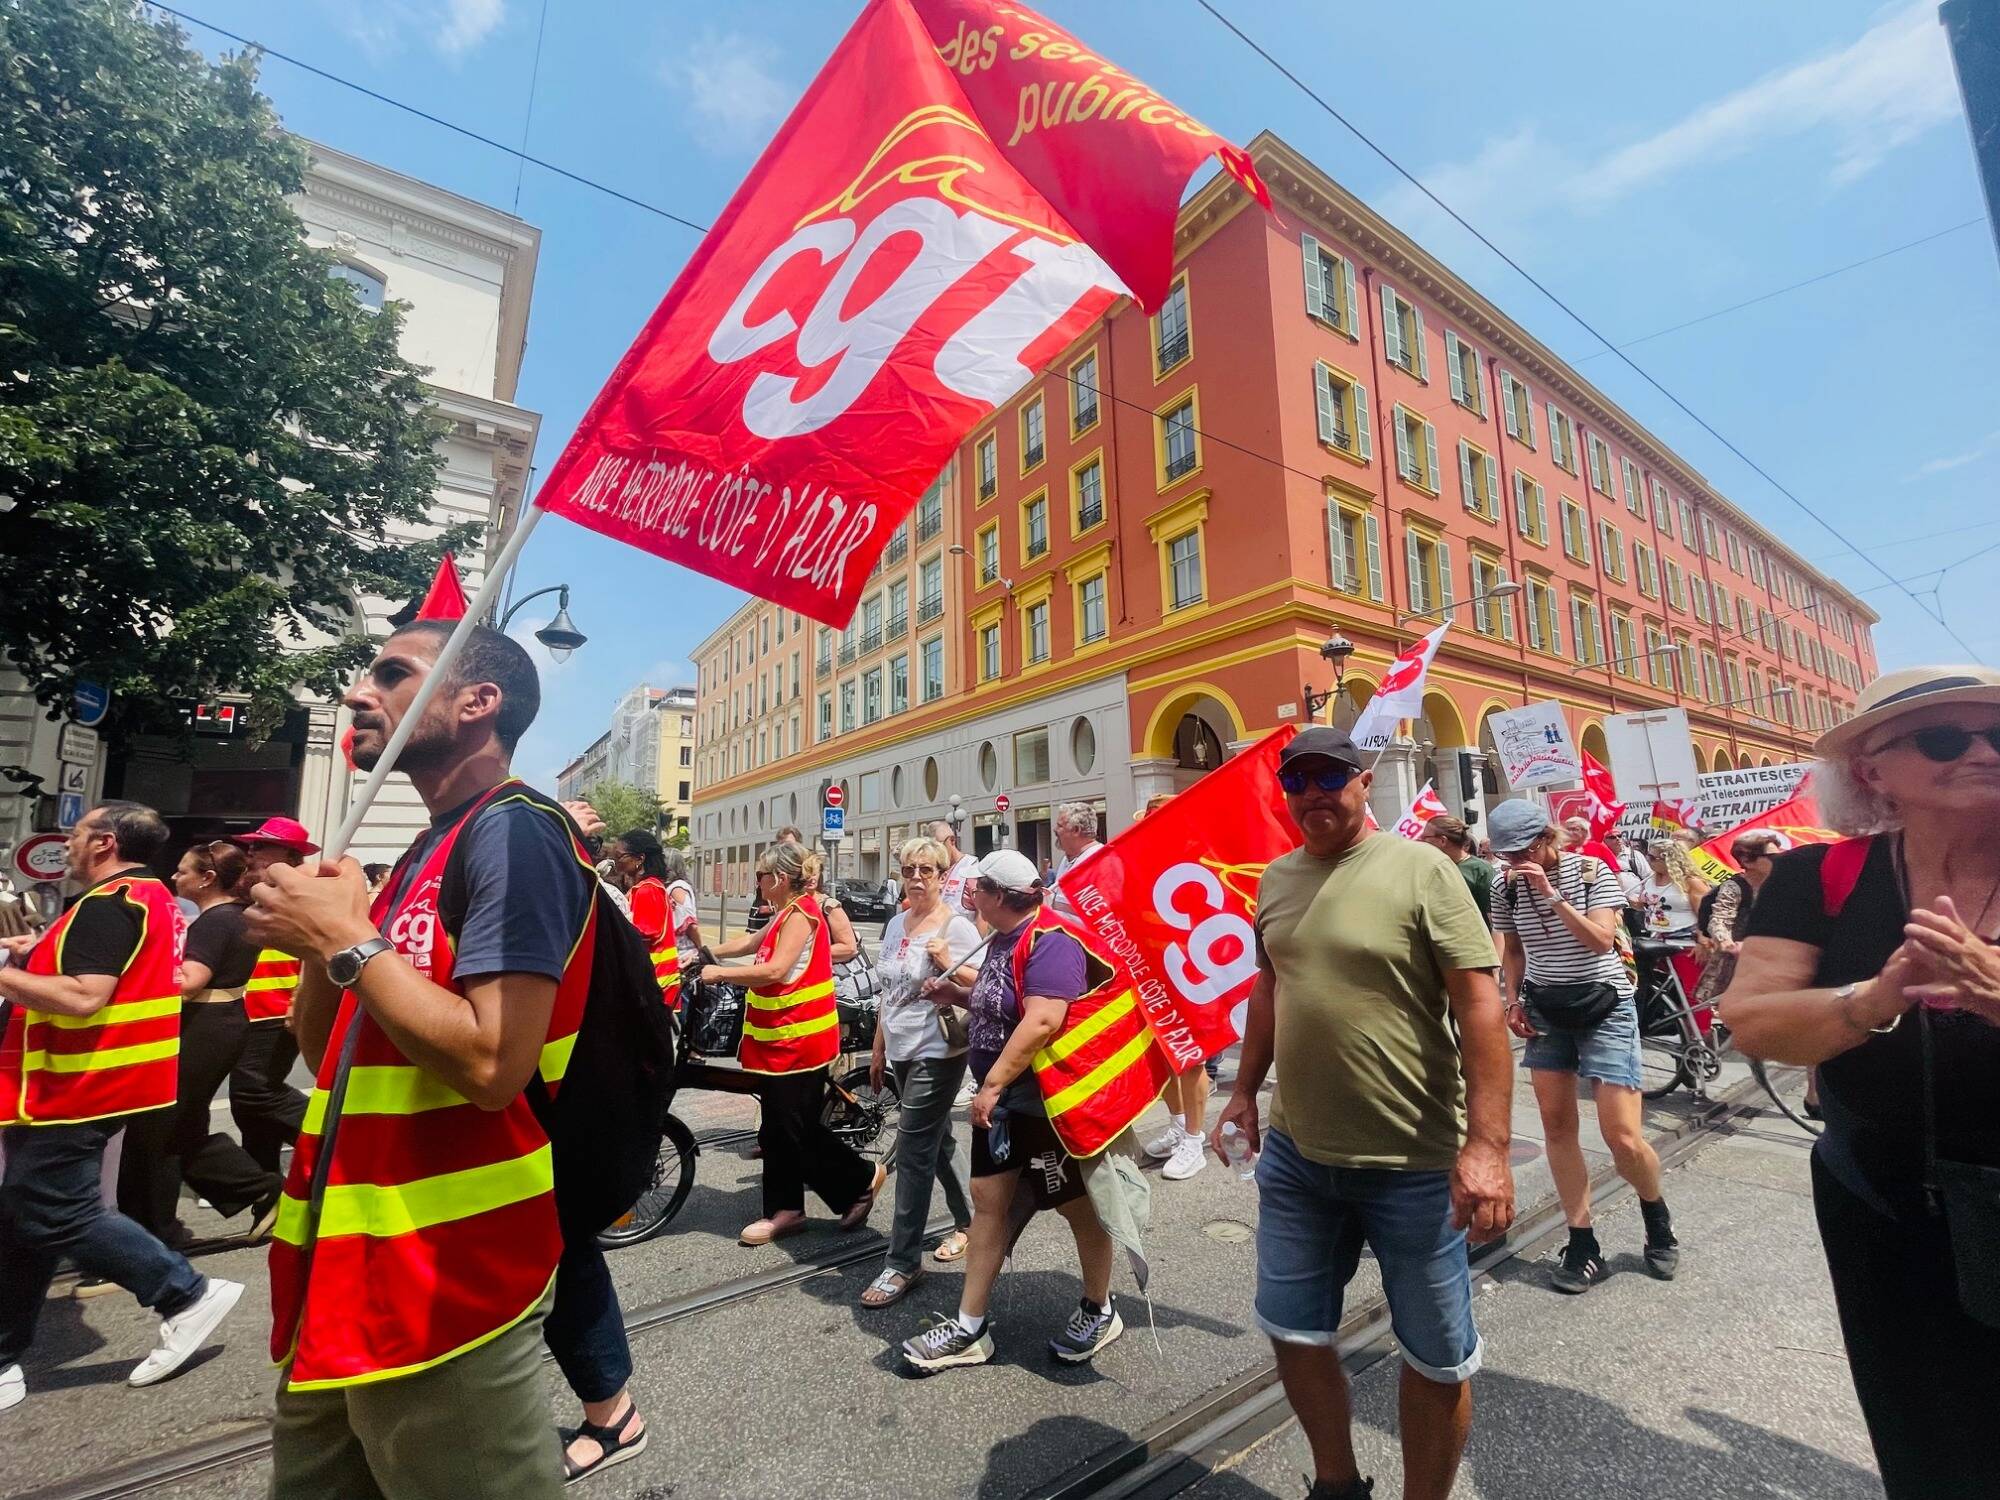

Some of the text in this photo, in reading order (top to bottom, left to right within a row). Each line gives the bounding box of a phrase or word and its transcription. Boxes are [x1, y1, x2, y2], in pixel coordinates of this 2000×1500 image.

[936, 20, 1004, 75] des
[707, 196, 1143, 439] cgt
[569, 452, 630, 513] NICE
[697, 462, 773, 557] CÔTE
[1072, 884, 1204, 1070] NICE MÉTROPOLE CÔTE D'AZUR
[1041, 1151, 1060, 1194] PUMA
